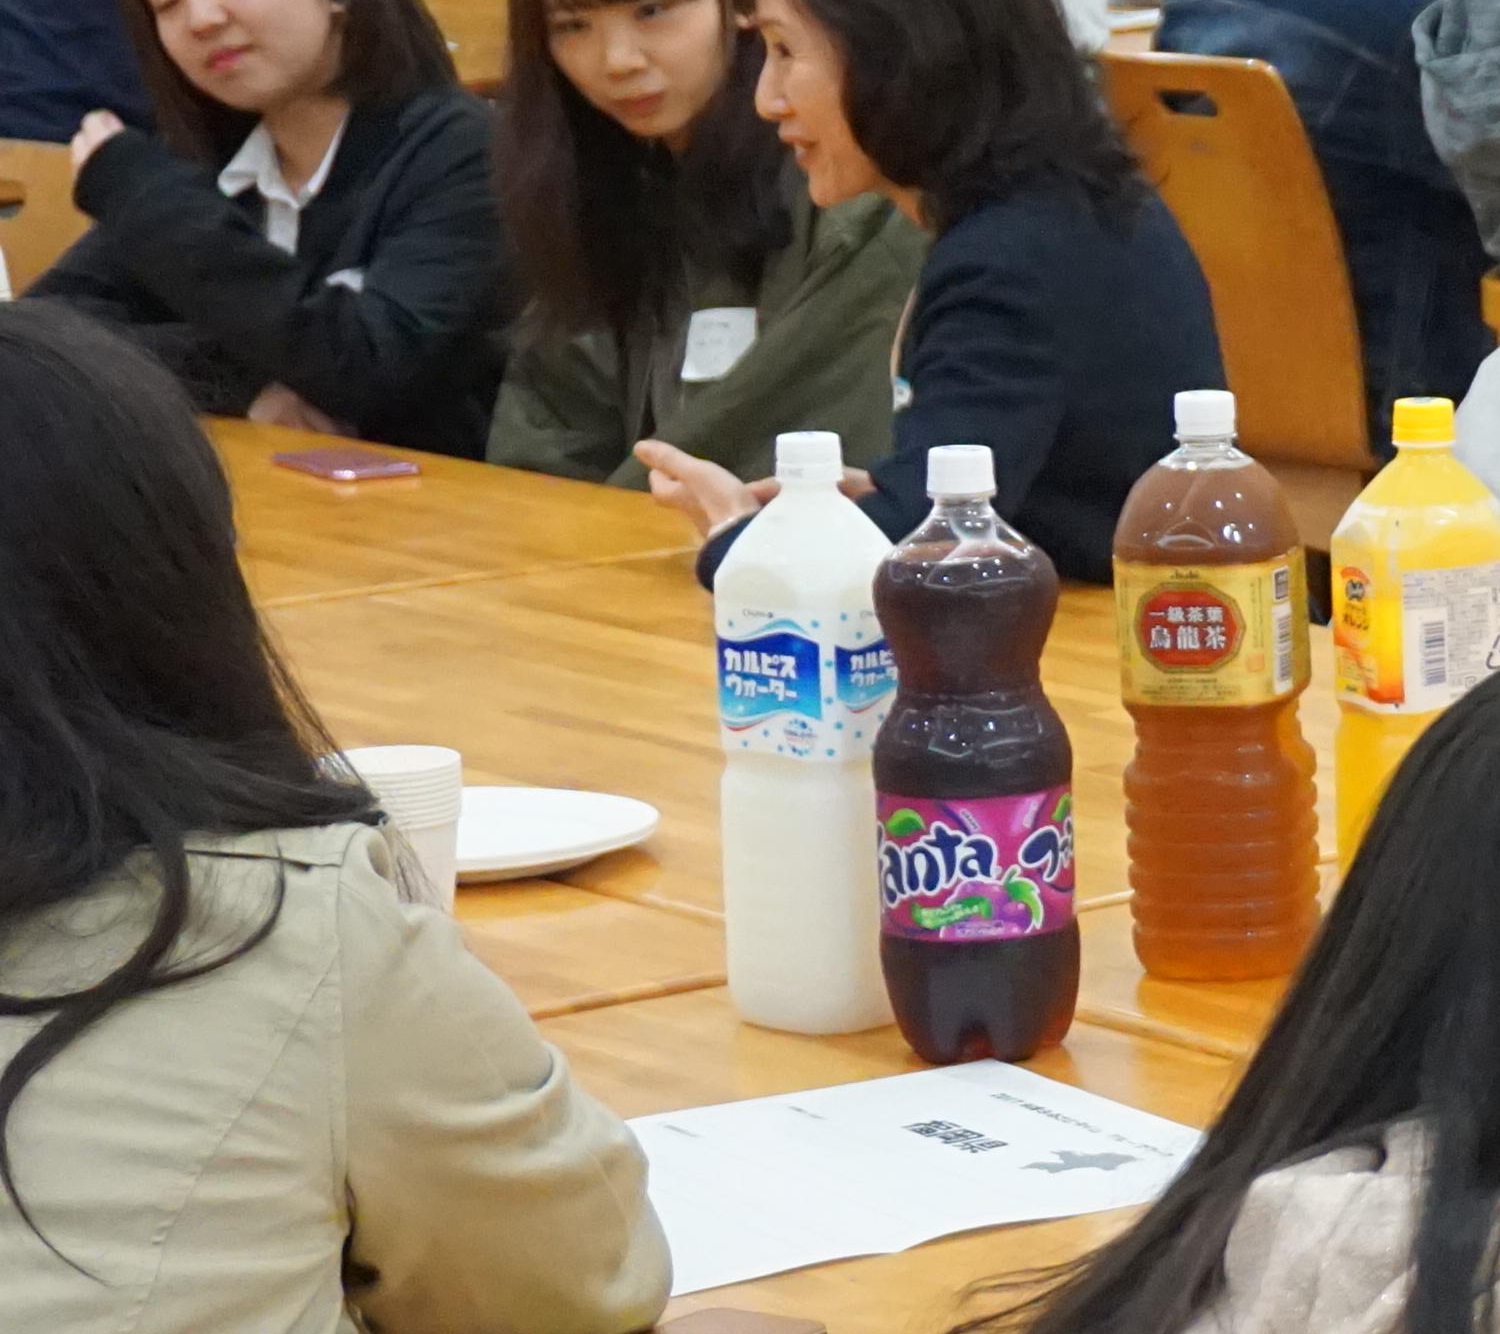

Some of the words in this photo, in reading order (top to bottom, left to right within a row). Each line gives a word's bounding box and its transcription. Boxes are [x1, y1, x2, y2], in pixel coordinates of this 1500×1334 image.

[1148, 605, 1225, 624] 一級茶葉
[1149, 624, 1227, 651] 烏龍茶
[723, 648, 797, 680] カルピス
[724, 672, 798, 702] ウォーター
[902, 1119, 1009, 1154] 福岡県
